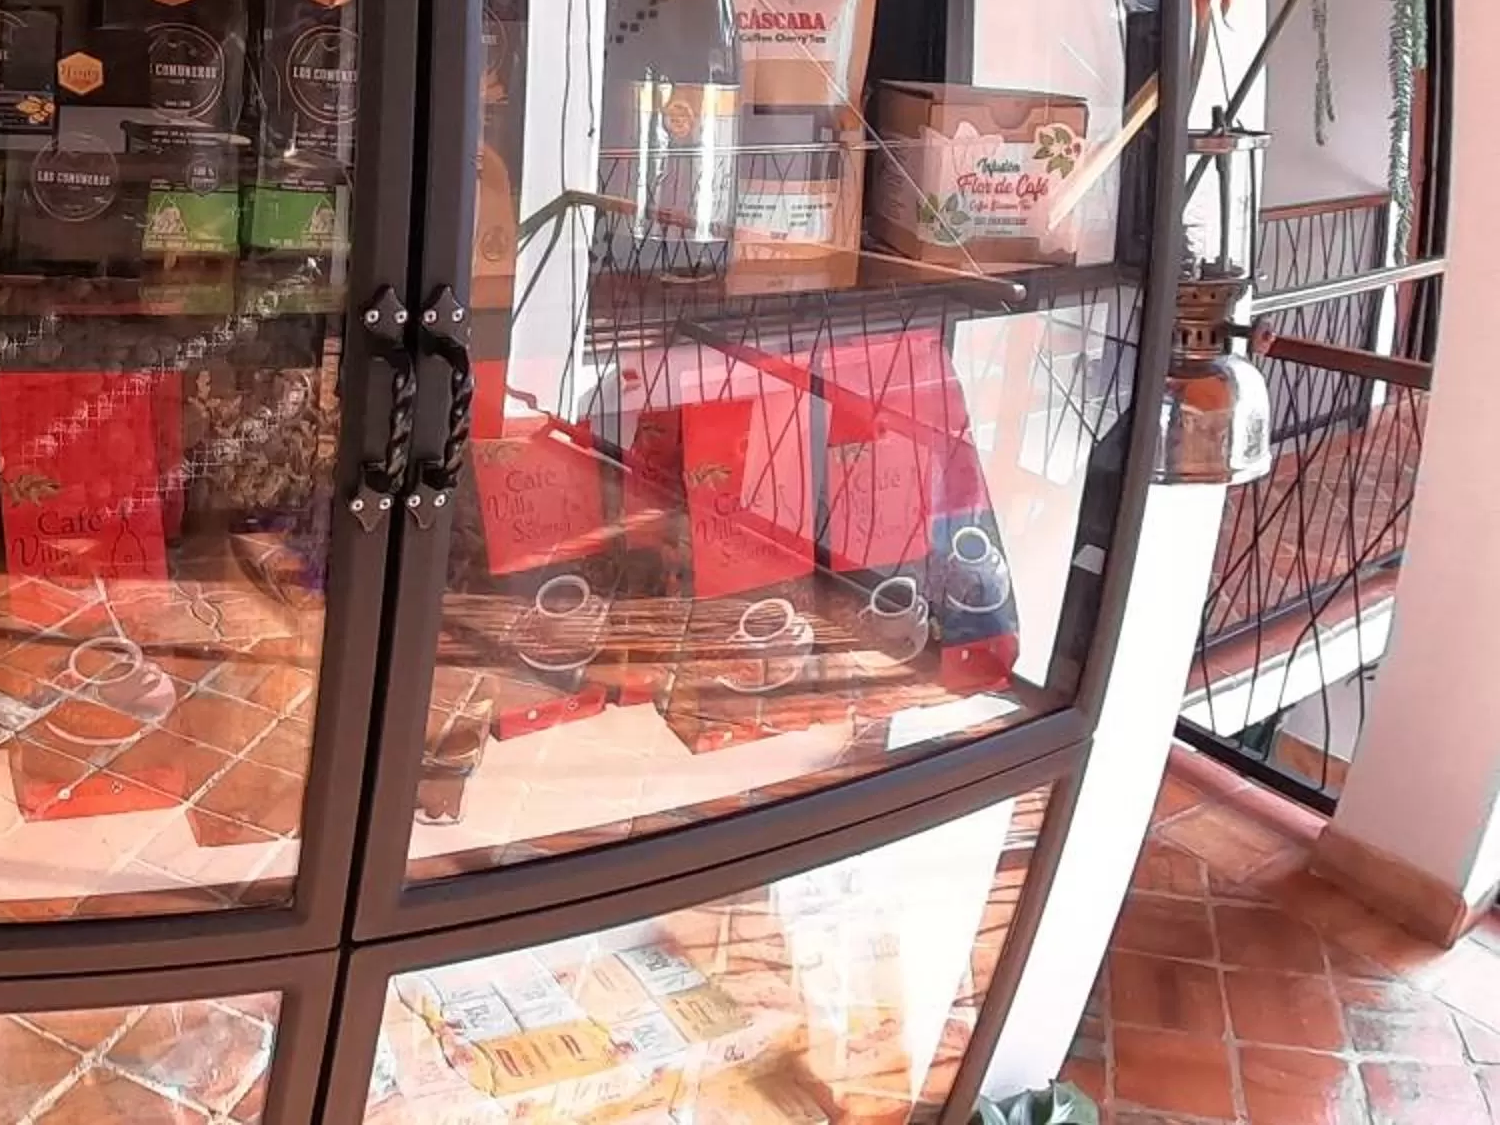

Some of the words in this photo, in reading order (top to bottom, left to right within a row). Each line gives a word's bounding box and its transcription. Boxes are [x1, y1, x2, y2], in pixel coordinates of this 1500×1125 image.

[736, 7, 826, 30] CÁSCARA
[740, 34, 772, 43] Coffee
[293, 67, 311, 79] LOS
[957, 173, 991, 196] Flor
[994, 179, 1012, 194] de
[1016, 173, 1048, 202] Café
[38, 508, 101, 534] Café
